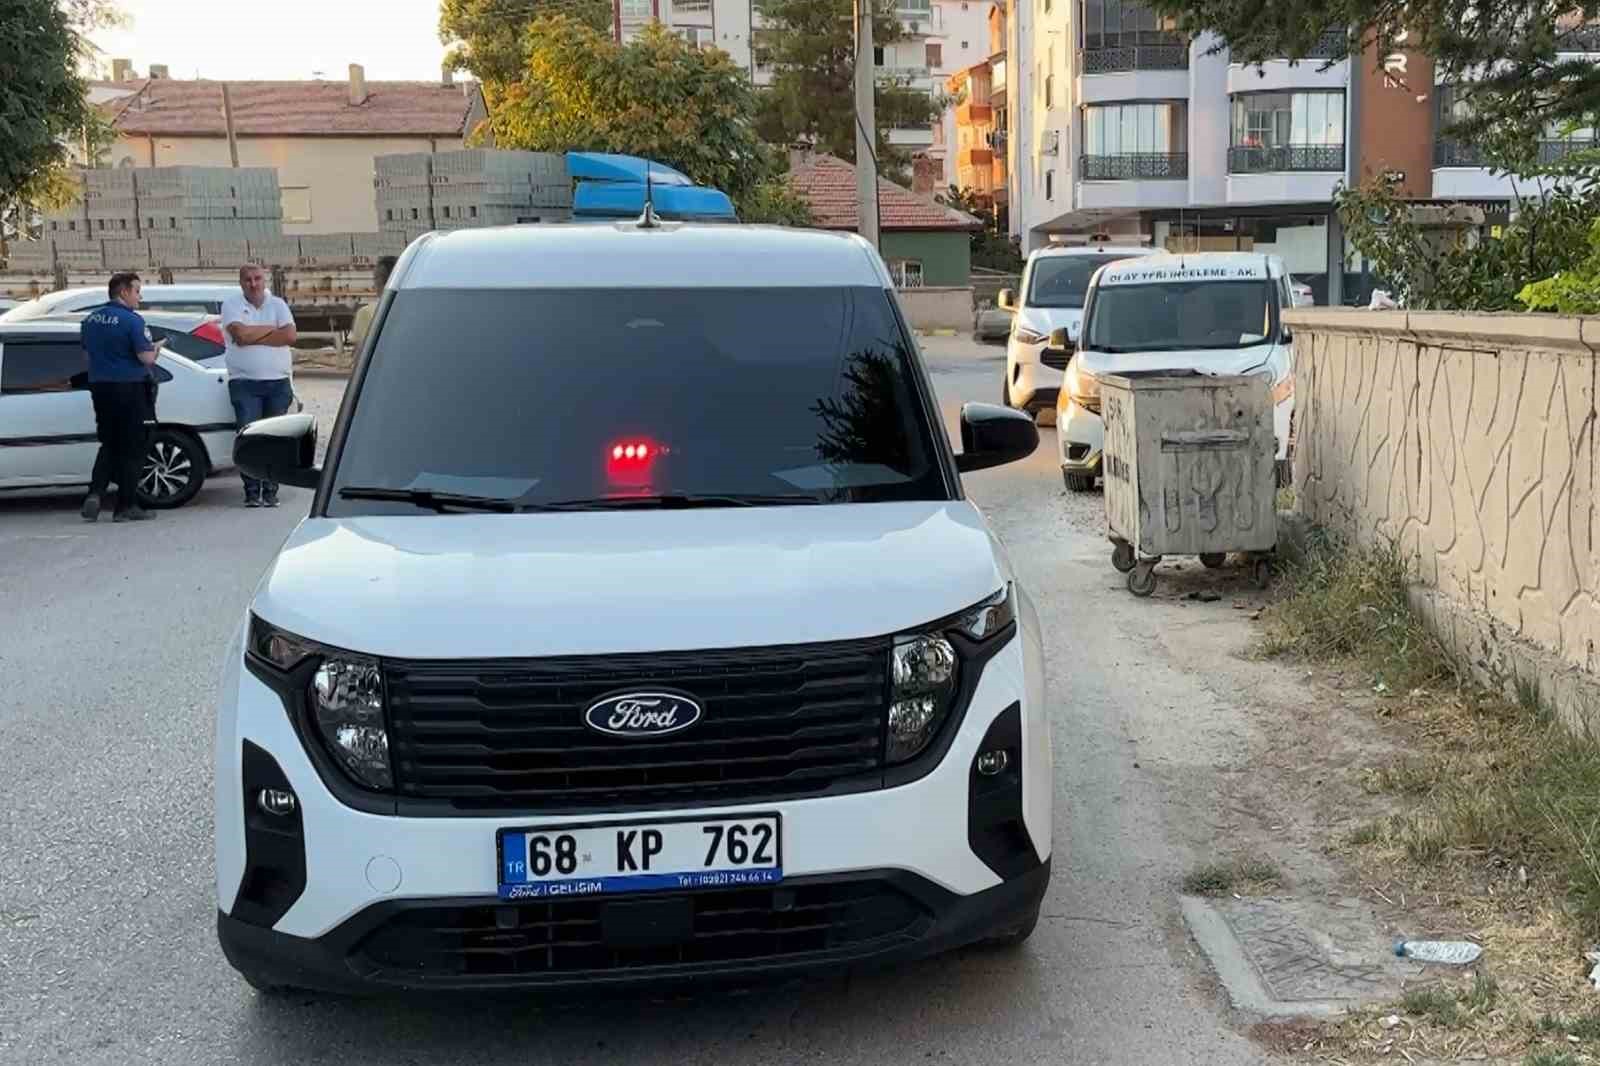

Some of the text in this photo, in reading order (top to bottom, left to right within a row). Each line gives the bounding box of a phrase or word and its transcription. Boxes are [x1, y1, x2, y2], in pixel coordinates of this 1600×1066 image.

[607, 699, 679, 729] Ford
[529, 824, 774, 877] 68 KP 762
[506, 860, 525, 874] TR
[508, 884, 543, 899] Ford
